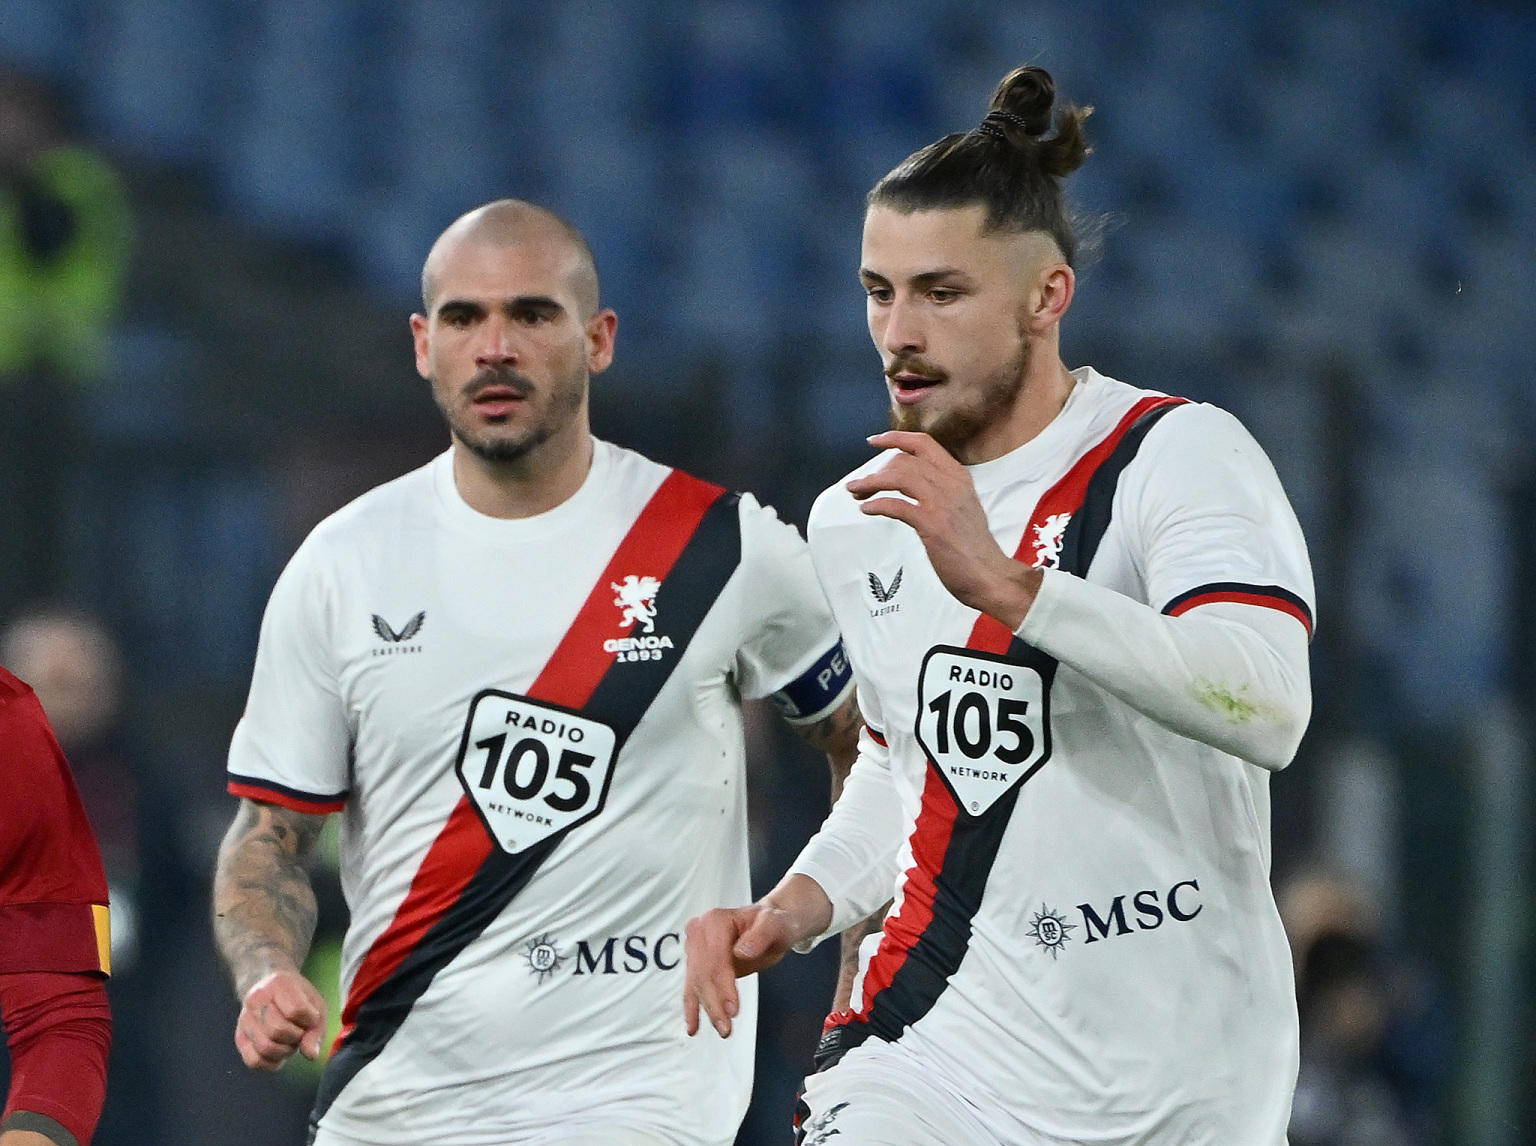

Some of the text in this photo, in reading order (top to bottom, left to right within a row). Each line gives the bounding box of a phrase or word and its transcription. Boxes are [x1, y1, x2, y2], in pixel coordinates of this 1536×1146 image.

[604, 635, 675, 653] GENOA
[617, 649, 663, 663] 1893
[816, 650, 848, 691] PE
[949, 665, 1013, 690] RADIO
[505, 710, 585, 743] RADIO
[928, 689, 1035, 765] 105
[475, 732, 596, 812] 105
[950, 765, 1008, 782] NETWORK
[488, 802, 553, 827] NETWORK
[1076, 879, 1203, 944] MSC
[573, 933, 681, 976] MSC
